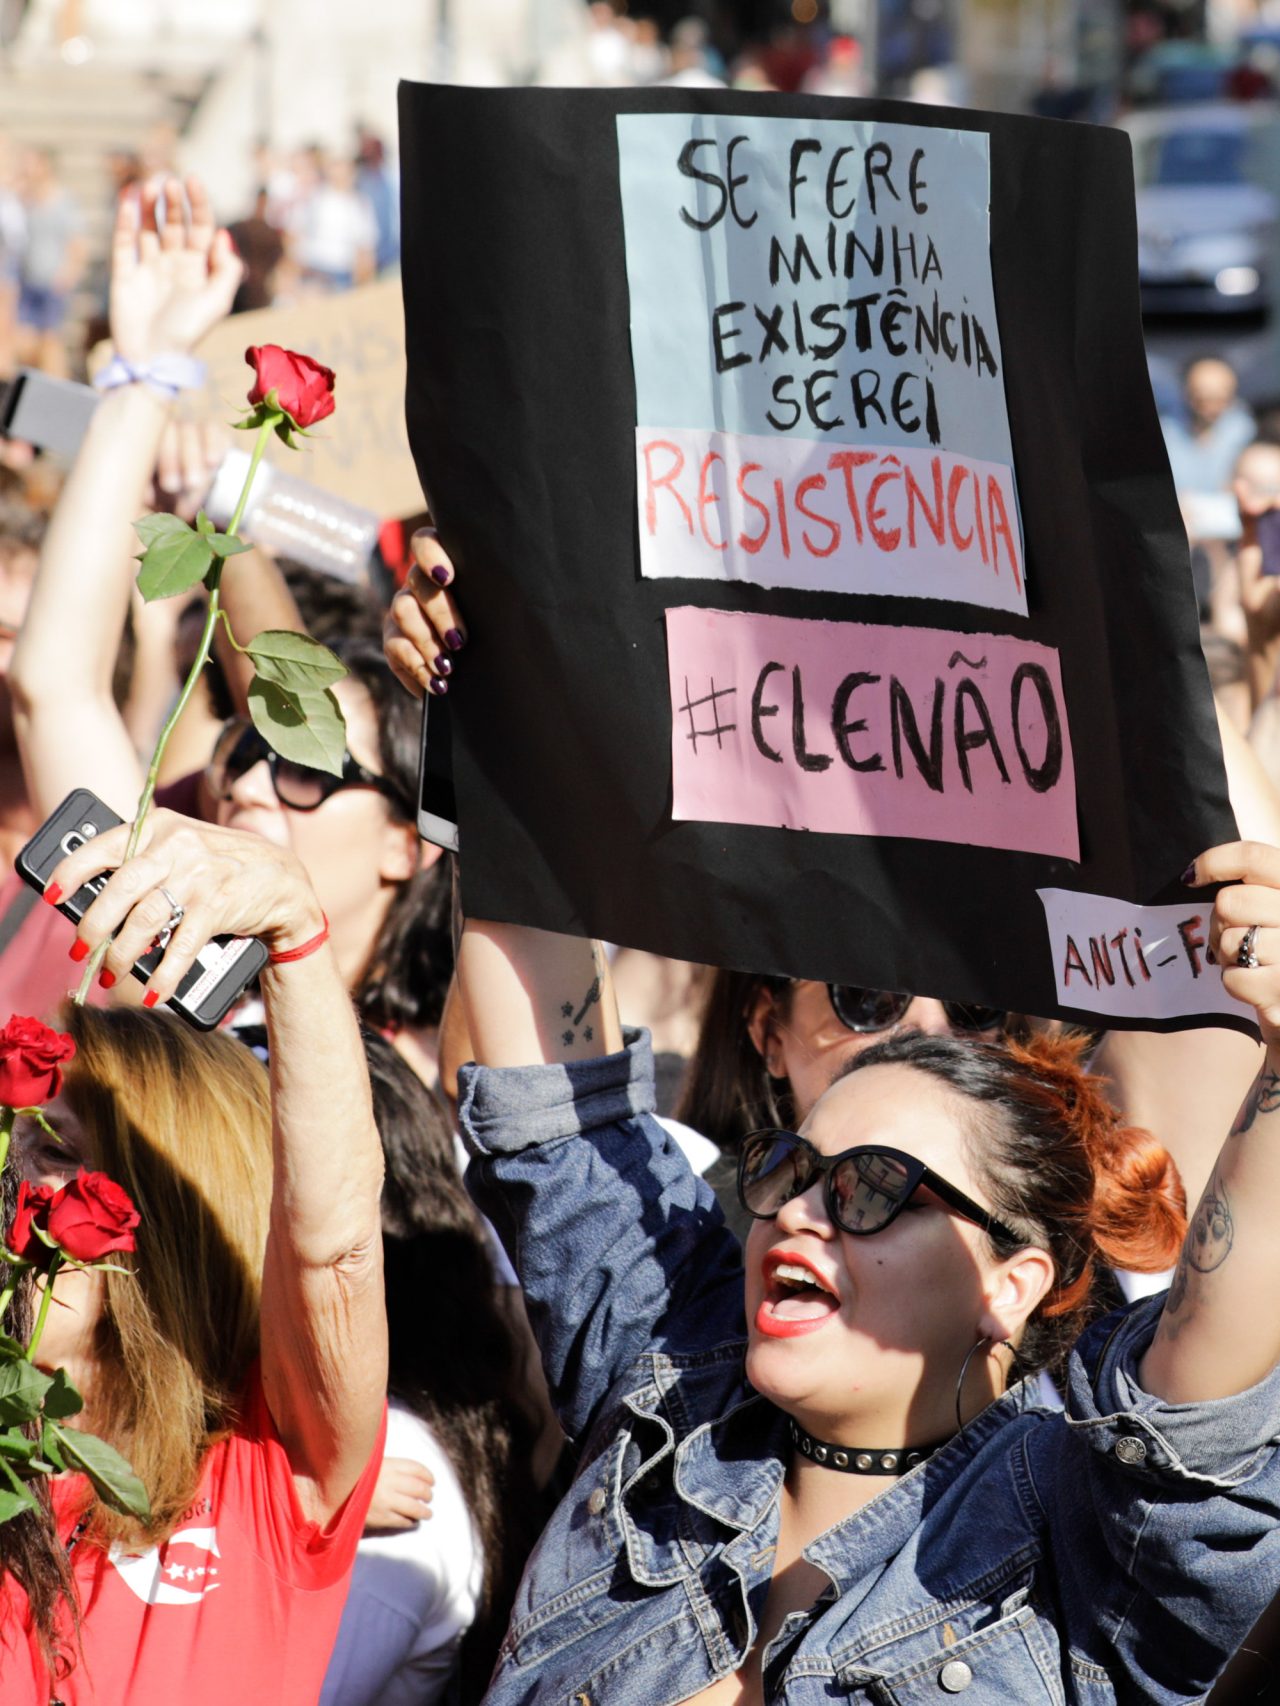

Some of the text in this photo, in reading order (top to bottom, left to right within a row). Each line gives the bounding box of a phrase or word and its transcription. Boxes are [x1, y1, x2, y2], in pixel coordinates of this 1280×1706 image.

[676, 135, 929, 232] SE FERE
[768, 220, 943, 287] MINHA
[642, 438, 1023, 596] RESISTÊNCIA
[678, 650, 1064, 795] #ELENÃO
